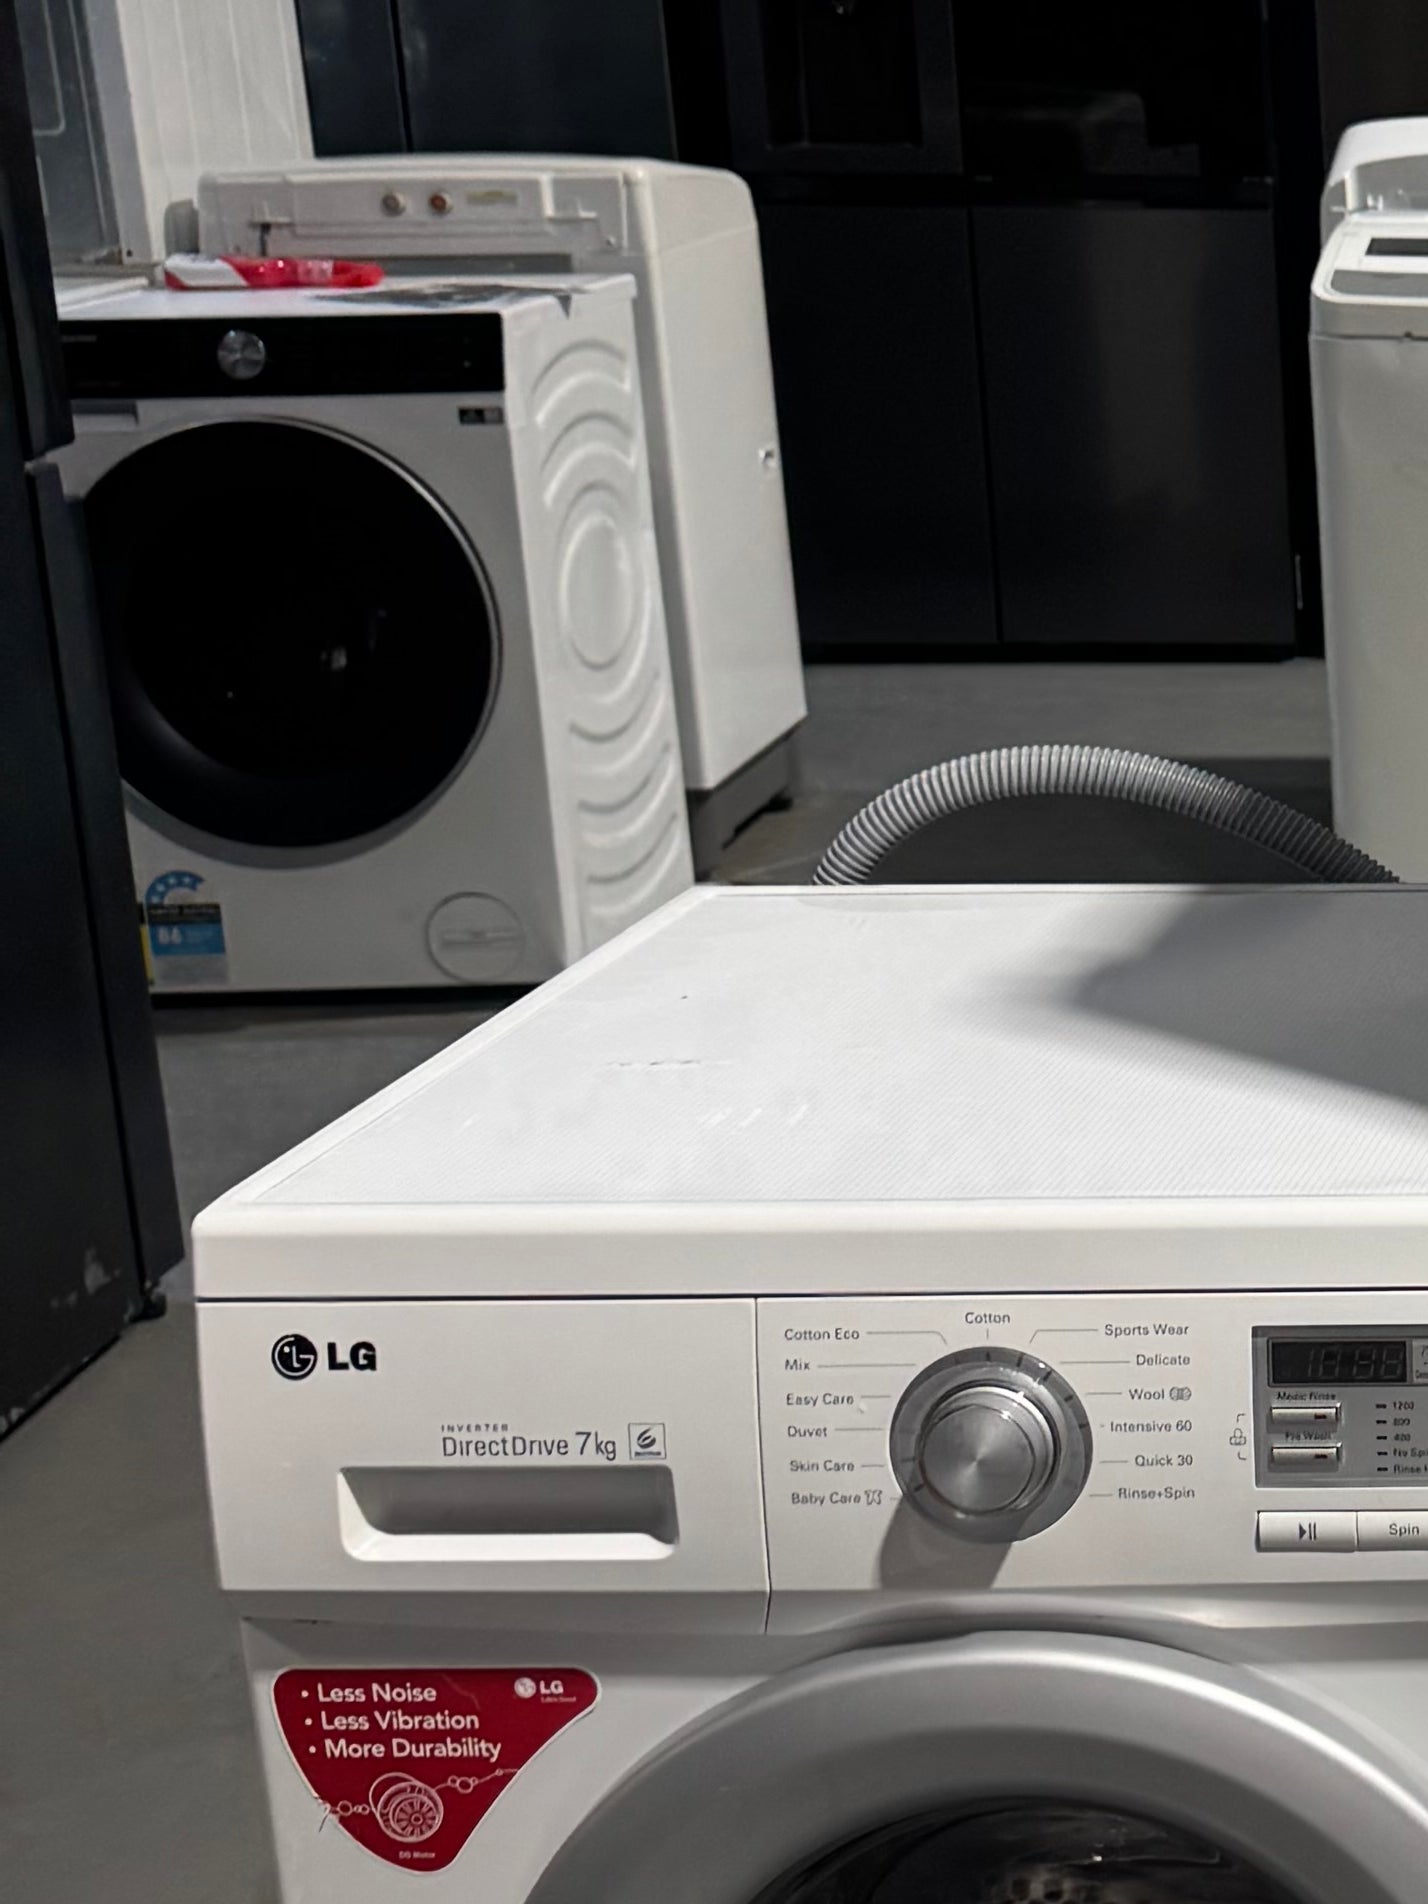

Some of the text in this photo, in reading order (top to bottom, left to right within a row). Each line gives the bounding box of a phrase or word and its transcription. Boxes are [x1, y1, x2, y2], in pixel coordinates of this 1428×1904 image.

[964, 1311, 1011, 1325] Cotton
[784, 1327, 860, 1341] Cotton Eco
[1104, 1323, 1189, 1338] Sports Wear
[326, 1341, 378, 1372] LG
[1136, 1354, 1191, 1367] Delicate
[784, 1358, 811, 1371] Mix
[786, 1392, 854, 1407] Easy Care
[1128, 1388, 1165, 1401] Wool
[441, 1424, 509, 1433] INVERTER
[787, 1425, 828, 1438] Duvet
[1110, 1420, 1193, 1433] Intensive 60
[789, 1459, 855, 1472] Skin Care
[1134, 1454, 1194, 1468] Quick 30
[791, 1491, 861, 1506] Baby Care
[1118, 1486, 1196, 1501] Rinse+Spin
[1388, 1523, 1420, 1537] Spin
[317, 1682, 437, 1703] Less Noise
[539, 1680, 564, 1695] LG
[321, 1710, 480, 1731] Less Vibration
[324, 1738, 502, 1763] More Durability
